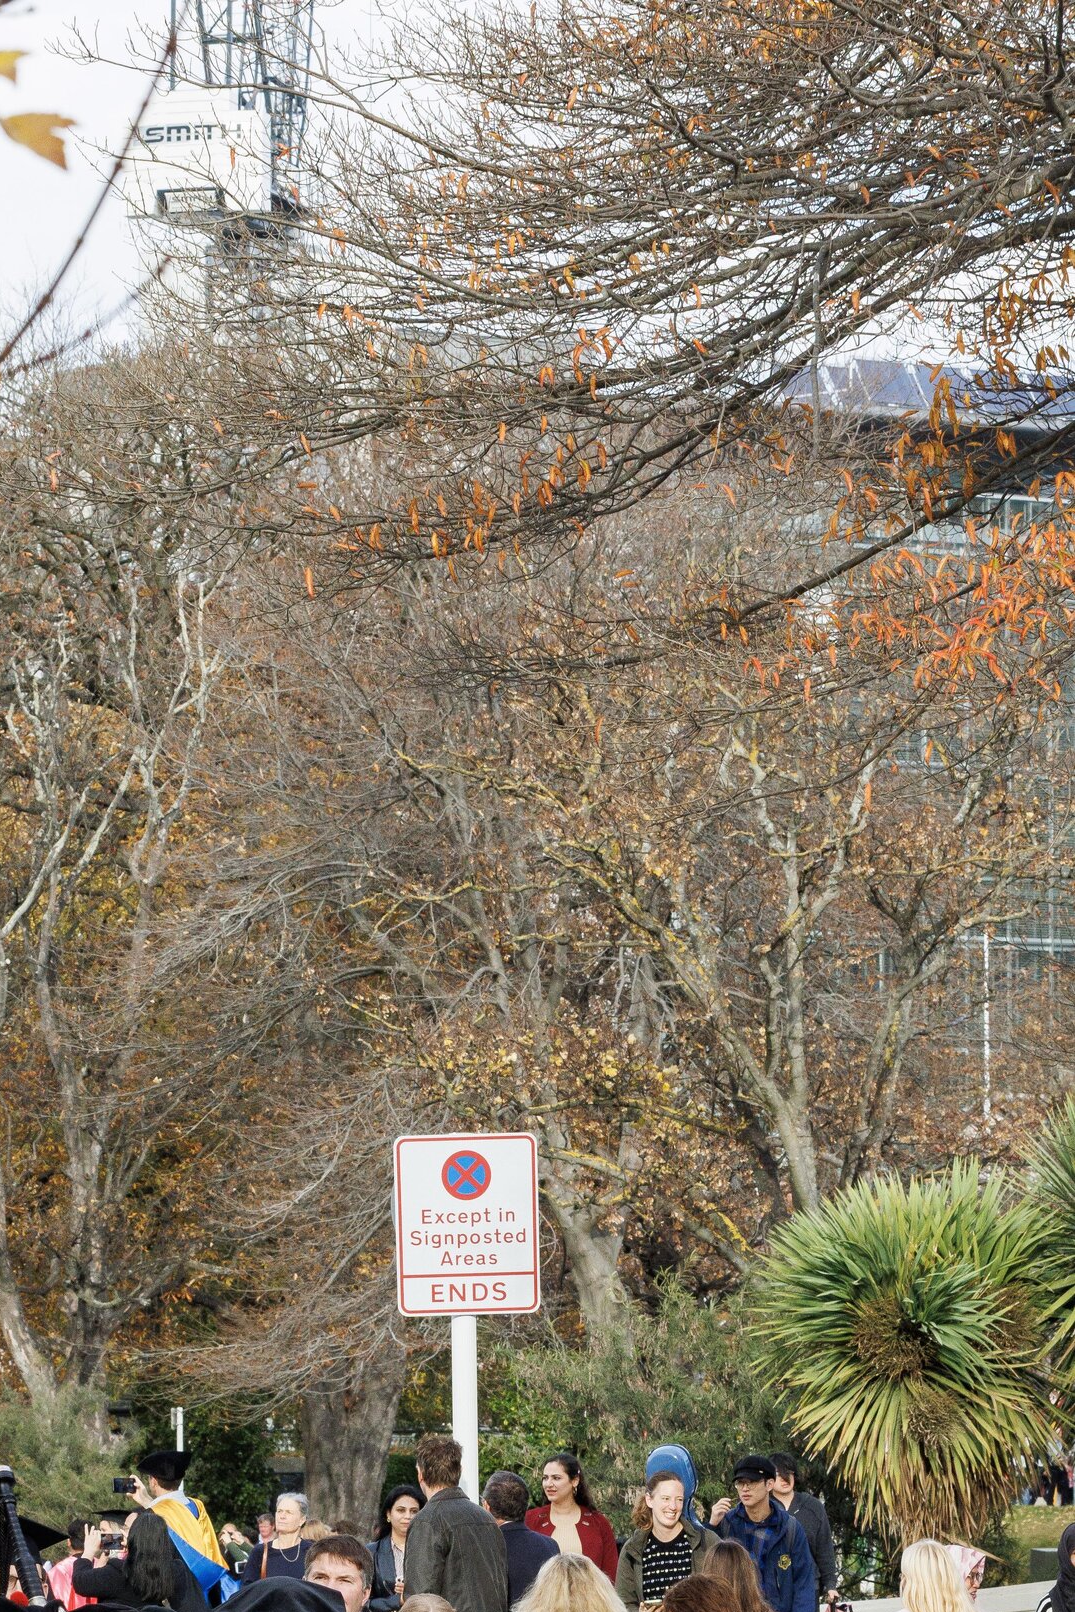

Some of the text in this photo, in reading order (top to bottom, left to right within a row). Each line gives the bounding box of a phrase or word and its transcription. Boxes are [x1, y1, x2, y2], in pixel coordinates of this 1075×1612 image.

[421, 1207, 516, 1227] Except in
[410, 1228, 527, 1249] Signposted
[440, 1250, 498, 1267] Areas
[431, 1282, 508, 1303] ENDS
